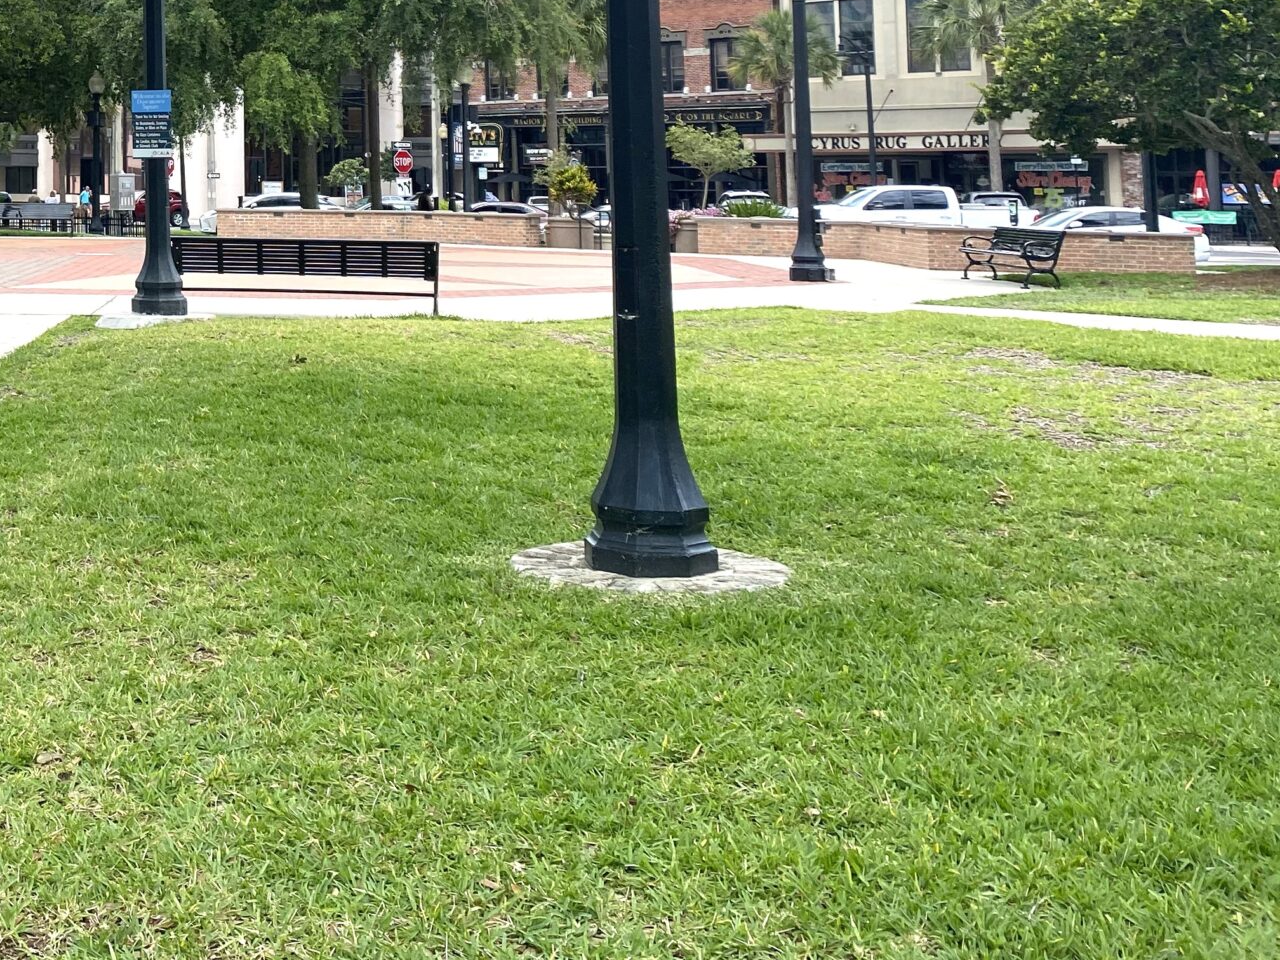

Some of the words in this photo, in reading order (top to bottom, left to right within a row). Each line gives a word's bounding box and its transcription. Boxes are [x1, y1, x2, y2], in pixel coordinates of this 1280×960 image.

[811, 136, 860, 149] CYRUS
[875, 135, 907, 149] RUG
[922, 134, 1001, 148] GALLER
[395, 158, 411, 166] STOP
